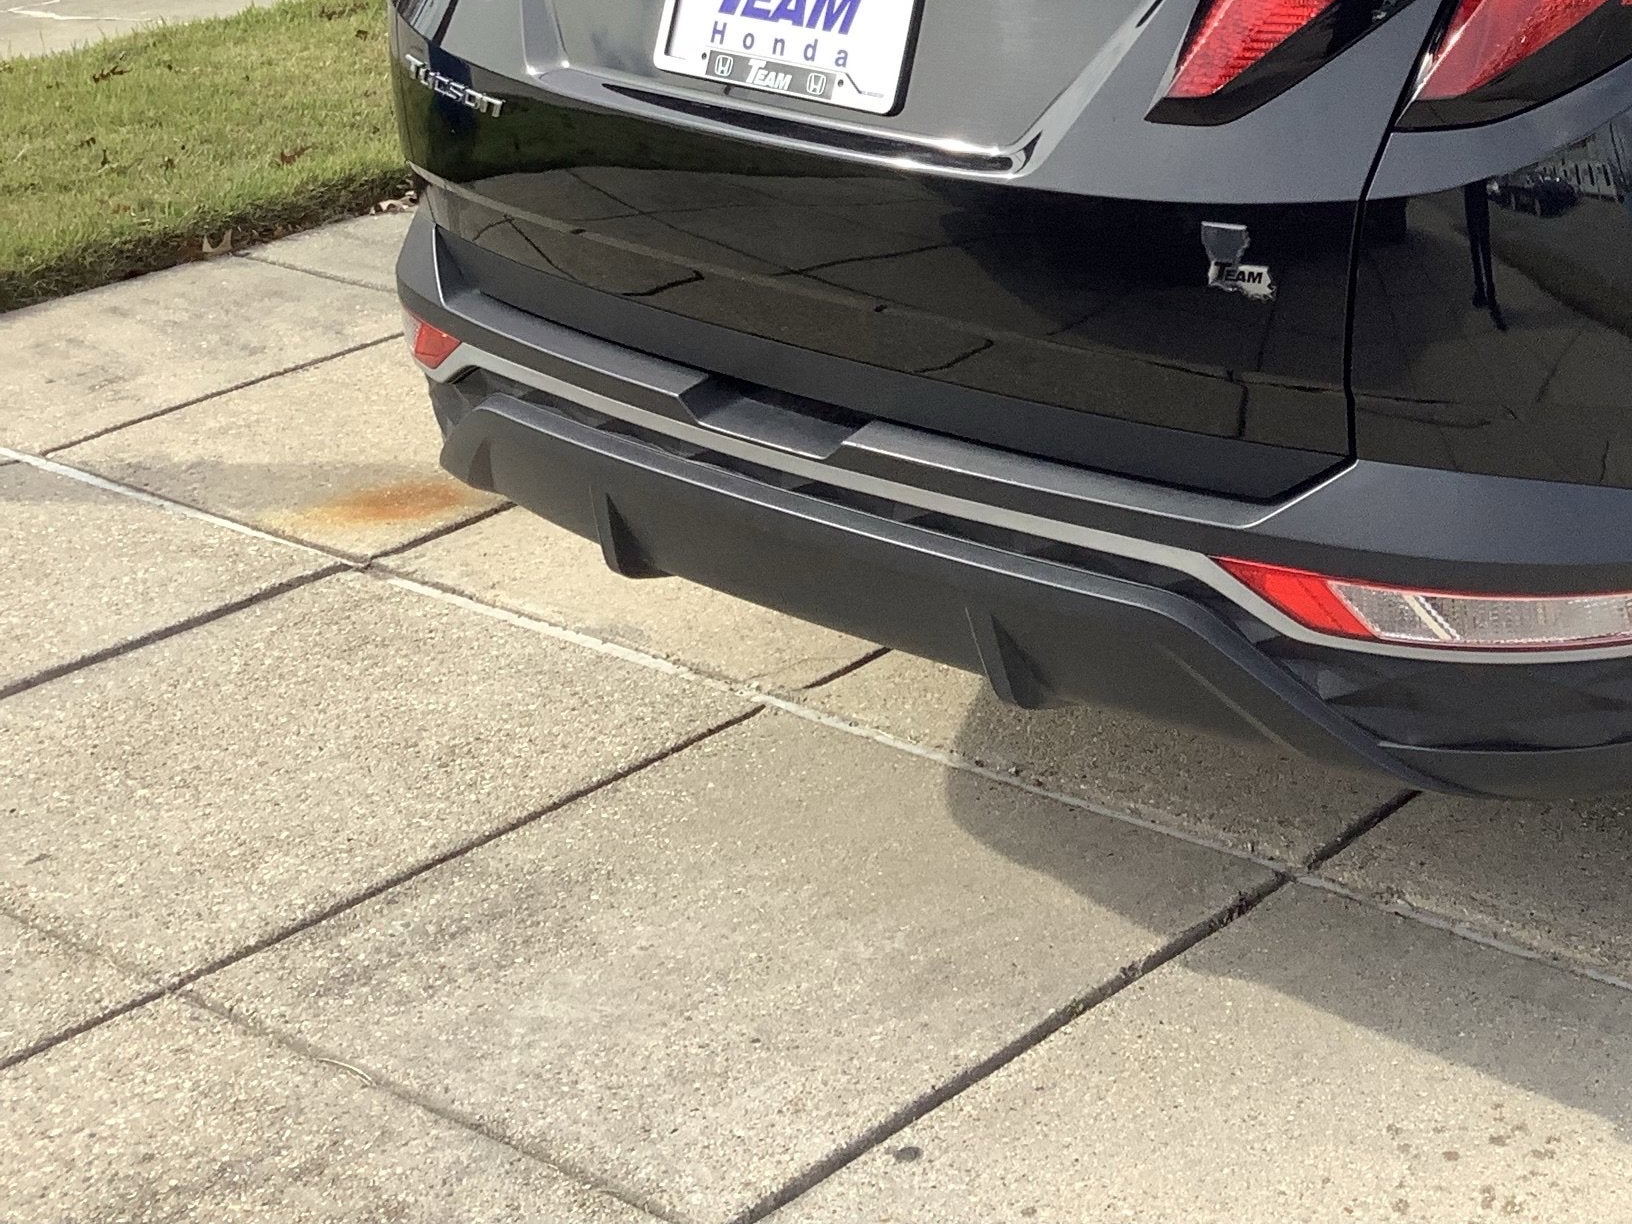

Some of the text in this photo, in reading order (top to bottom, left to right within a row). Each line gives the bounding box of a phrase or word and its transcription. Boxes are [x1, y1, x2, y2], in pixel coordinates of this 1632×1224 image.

[709, 20, 850, 68] Honda
[745, 58, 793, 91] TEAM
[1213, 261, 1264, 285] TEAM
